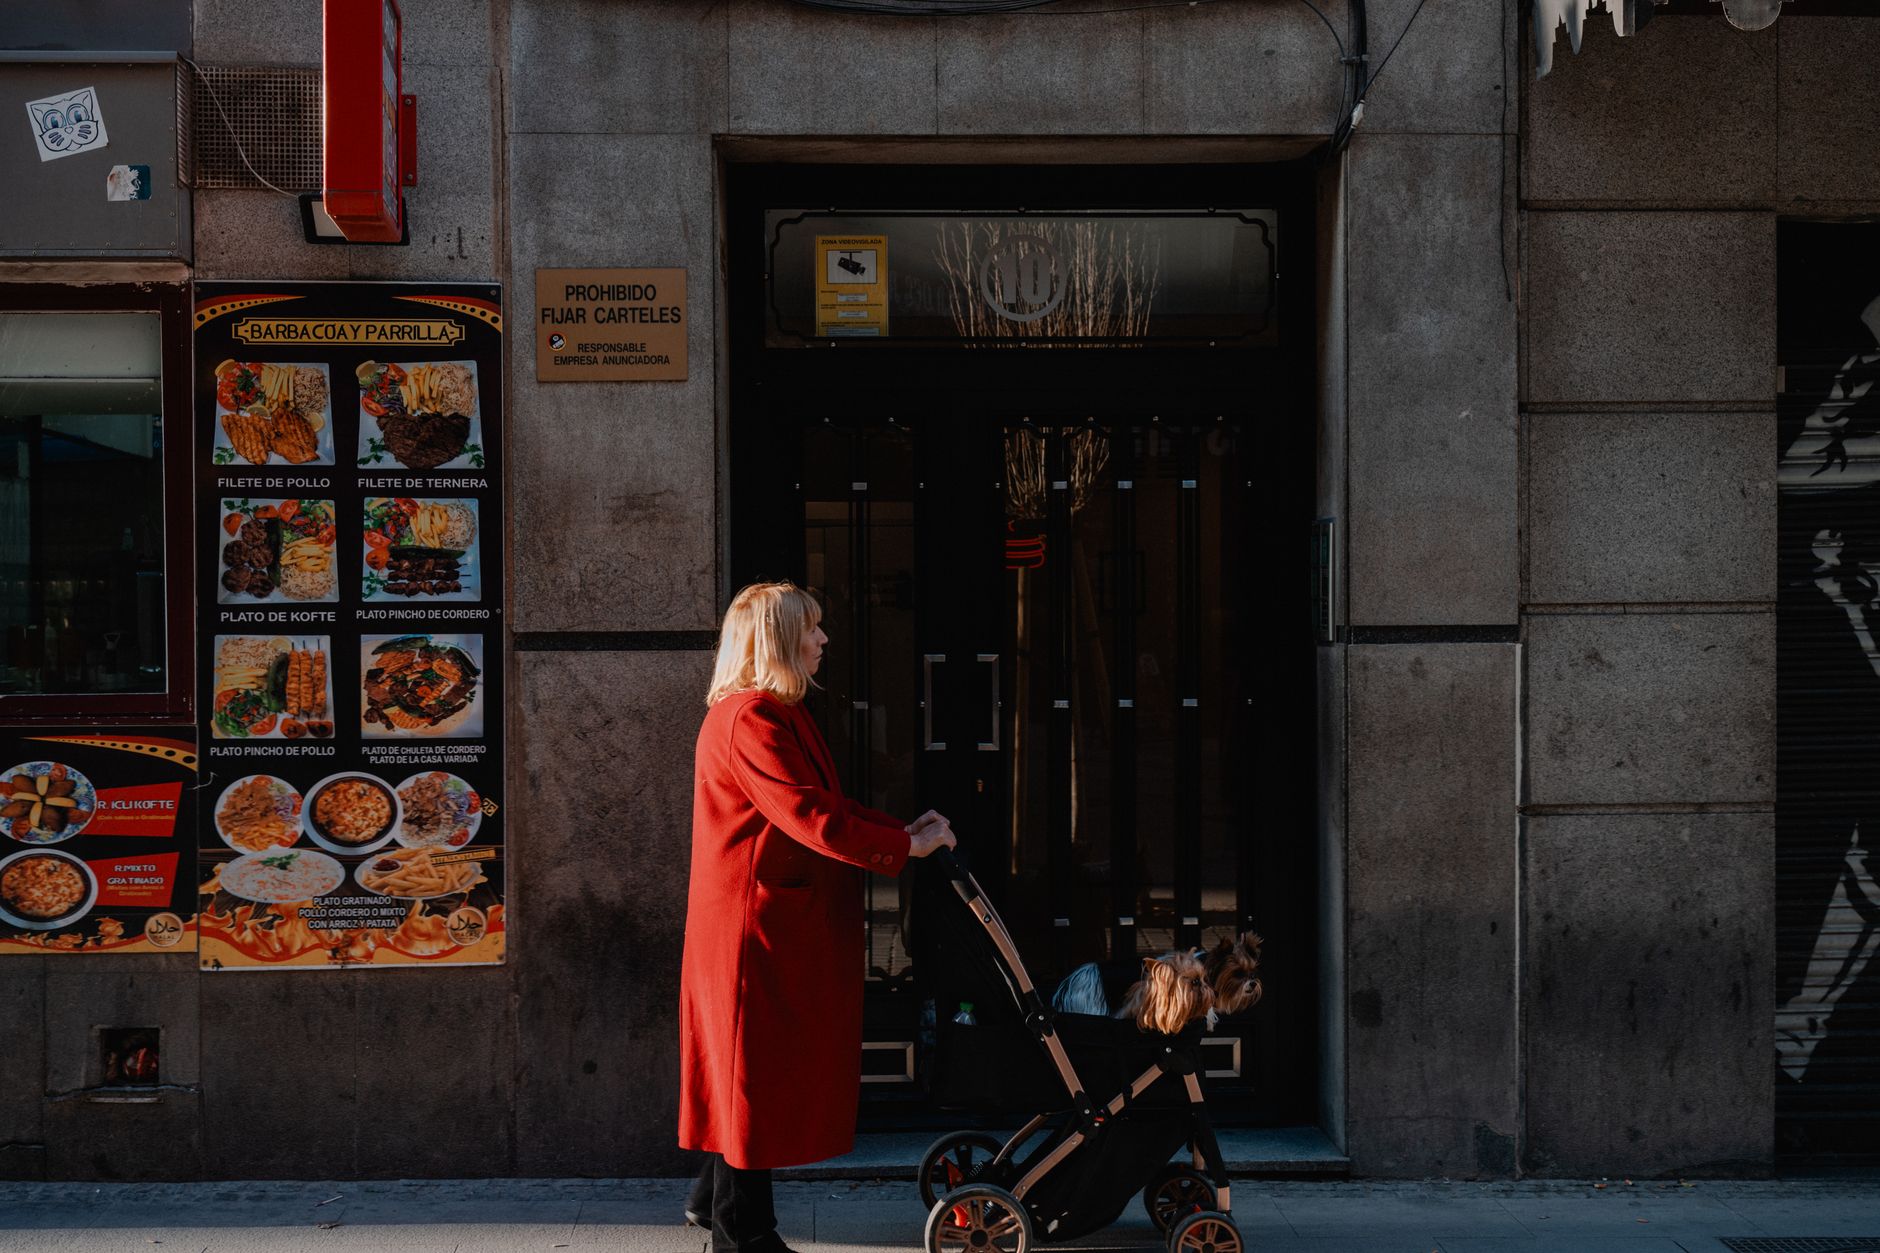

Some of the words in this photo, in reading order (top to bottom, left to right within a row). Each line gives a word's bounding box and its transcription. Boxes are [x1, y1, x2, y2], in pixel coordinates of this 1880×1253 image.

[565, 284, 657, 301] PROHIBIDO
[541, 307, 586, 324] FIJAR
[594, 306, 681, 324] CARTELES
[365, 324, 451, 341] PARRILLA
[577, 342, 647, 353] RESPONSABLE
[554, 355, 599, 365] EMPRESA
[602, 354, 671, 365] ANUNCIADORA
[217, 477, 263, 488] FILETE
[265, 477, 284, 488] DE
[286, 477, 331, 488] POLLO
[357, 478, 403, 488] FILETE
[405, 478, 424, 488] DE
[426, 478, 489, 489] TERNERA
[220, 611, 265, 623] PLATO
[268, 611, 288, 622] DE
[290, 611, 337, 622] KOFTE
[355, 609, 387, 620] PLATO
[388, 609, 426, 620] PINCHO
[427, 609, 442, 620] DE
[442, 609, 491, 620] CORDERO
[210, 746, 243, 757] PLATO
[244, 746, 284, 757] PINCHO
[285, 746, 300, 756] DE
[301, 745, 336, 756] POLLO
[361, 746, 387, 756] PLATO
[388, 746, 400, 755] DE
[400, 746, 434, 755] CHULETA
[434, 745, 446, 755] DE
[446, 745, 487, 755] CORDERO
[369, 755, 396, 765] PLATO
[396, 755, 408, 764] DE
[408, 755, 420, 764] LA
[420, 755, 442, 764] CASA
[443, 754, 479, 764] VARIADA
[313, 896, 341, 906] PLATO
[341, 895, 392, 905] GRATINADO
[298, 907, 327, 918] POLLO
[327, 906, 371, 917] CORDERO
[371, 907, 379, 917] O
[379, 906, 407, 917] MIXTO
[308, 919, 328, 929] CON
[328, 919, 359, 929] ARROZ
[359, 918, 366, 928] Y
[366, 918, 397, 928] PATATA
